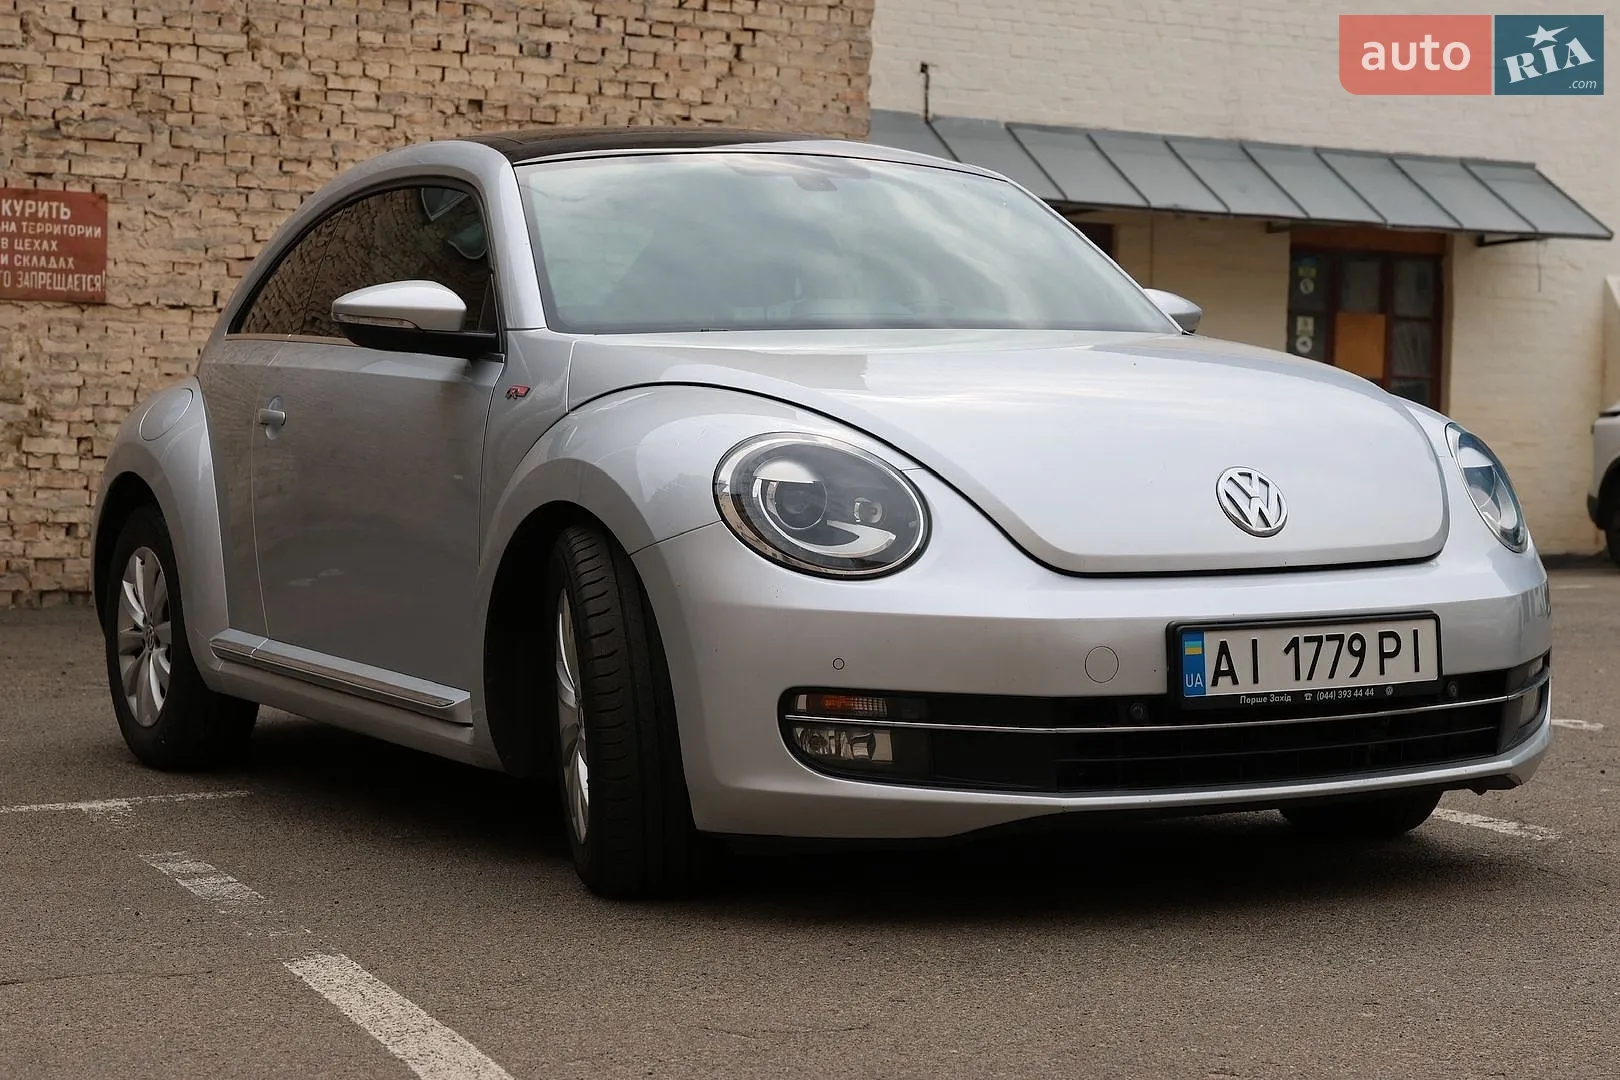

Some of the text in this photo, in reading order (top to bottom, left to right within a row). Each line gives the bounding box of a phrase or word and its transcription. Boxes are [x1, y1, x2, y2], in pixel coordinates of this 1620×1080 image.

[1, 198, 71, 220] КУРИТЬ
[1, 220, 101, 238] НА ТЕРРИТОРИИ
[1, 237, 58, 252] В ЦЕХАХ
[0, 253, 75, 269] И СКЛАДАХ
[16, 269, 106, 292] ЗАПРЕЩАЕТСЯ!
[1211, 628, 1420, 687] AI 1779 PI
[1185, 673, 1204, 688] UA
[1240, 693, 1292, 705] Порше Захід
[1316, 690, 1336, 701] (044)
[1338, 689, 1352, 699] 393
[1353, 688, 1363, 698] 44
[1364, 687, 1375, 697] 44
